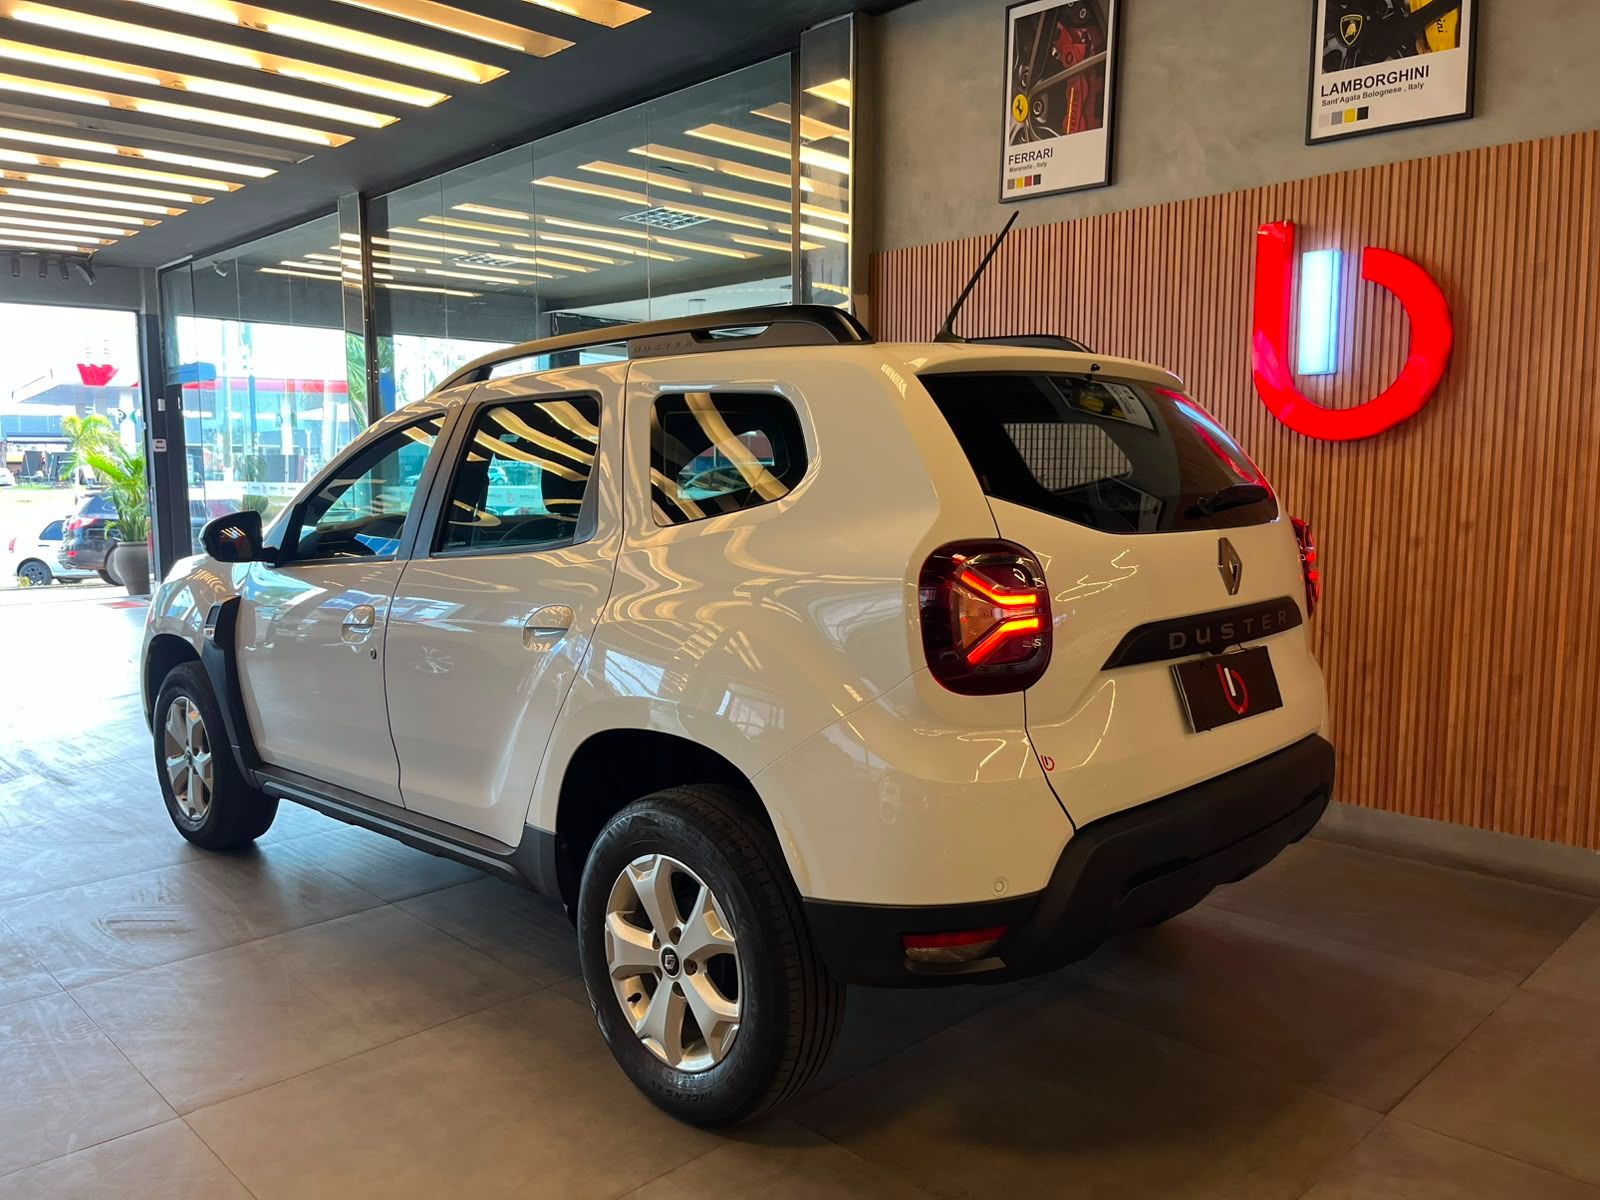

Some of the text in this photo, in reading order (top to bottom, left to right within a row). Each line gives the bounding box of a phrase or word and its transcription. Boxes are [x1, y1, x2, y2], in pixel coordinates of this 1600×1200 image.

[1321, 65, 1430, 97] LAMBORGHINI
[1321, 94, 1361, 107] Sant'Agata
[1362, 86, 1402, 99] Bolognese
[1408, 82, 1424, 91] Italy
[1008, 147, 1053, 165] FERRARI
[1168, 609, 1288, 650] DUSTER
